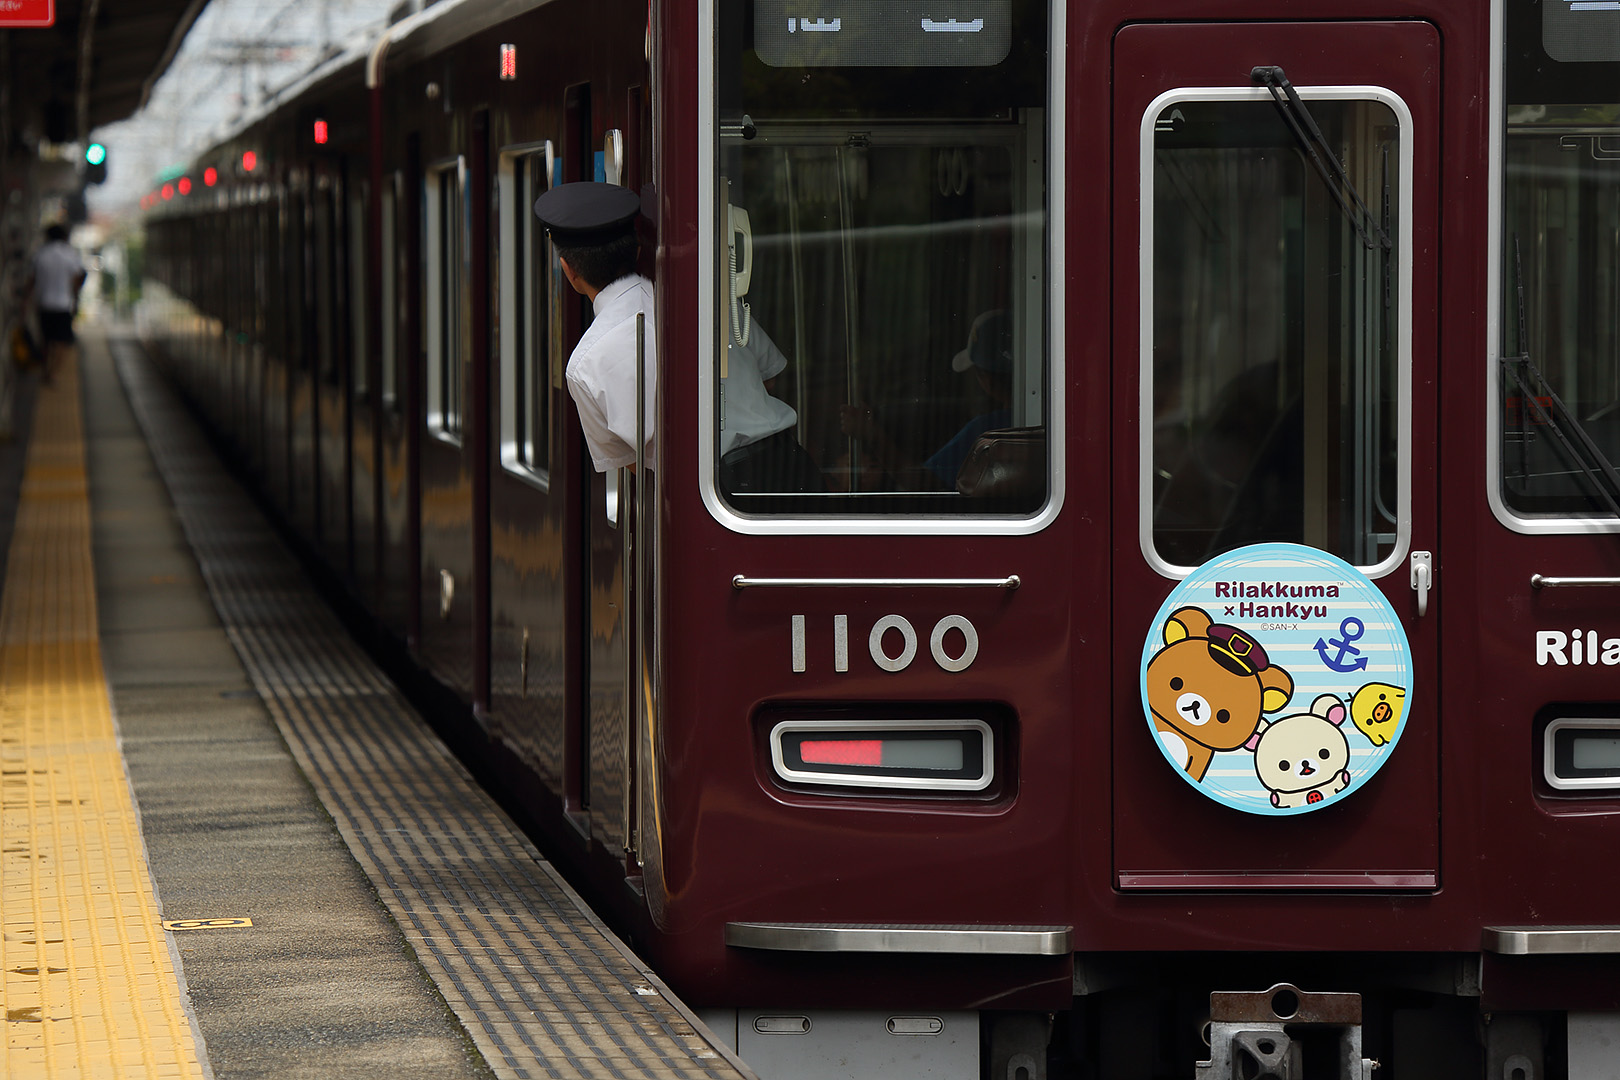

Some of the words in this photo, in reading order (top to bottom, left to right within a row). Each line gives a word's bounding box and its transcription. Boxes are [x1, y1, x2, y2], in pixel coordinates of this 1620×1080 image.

[1215, 581, 1339, 598] Rilakkuma
[792, 614, 978, 672] 1100
[1536, 628, 1620, 665] Rila
